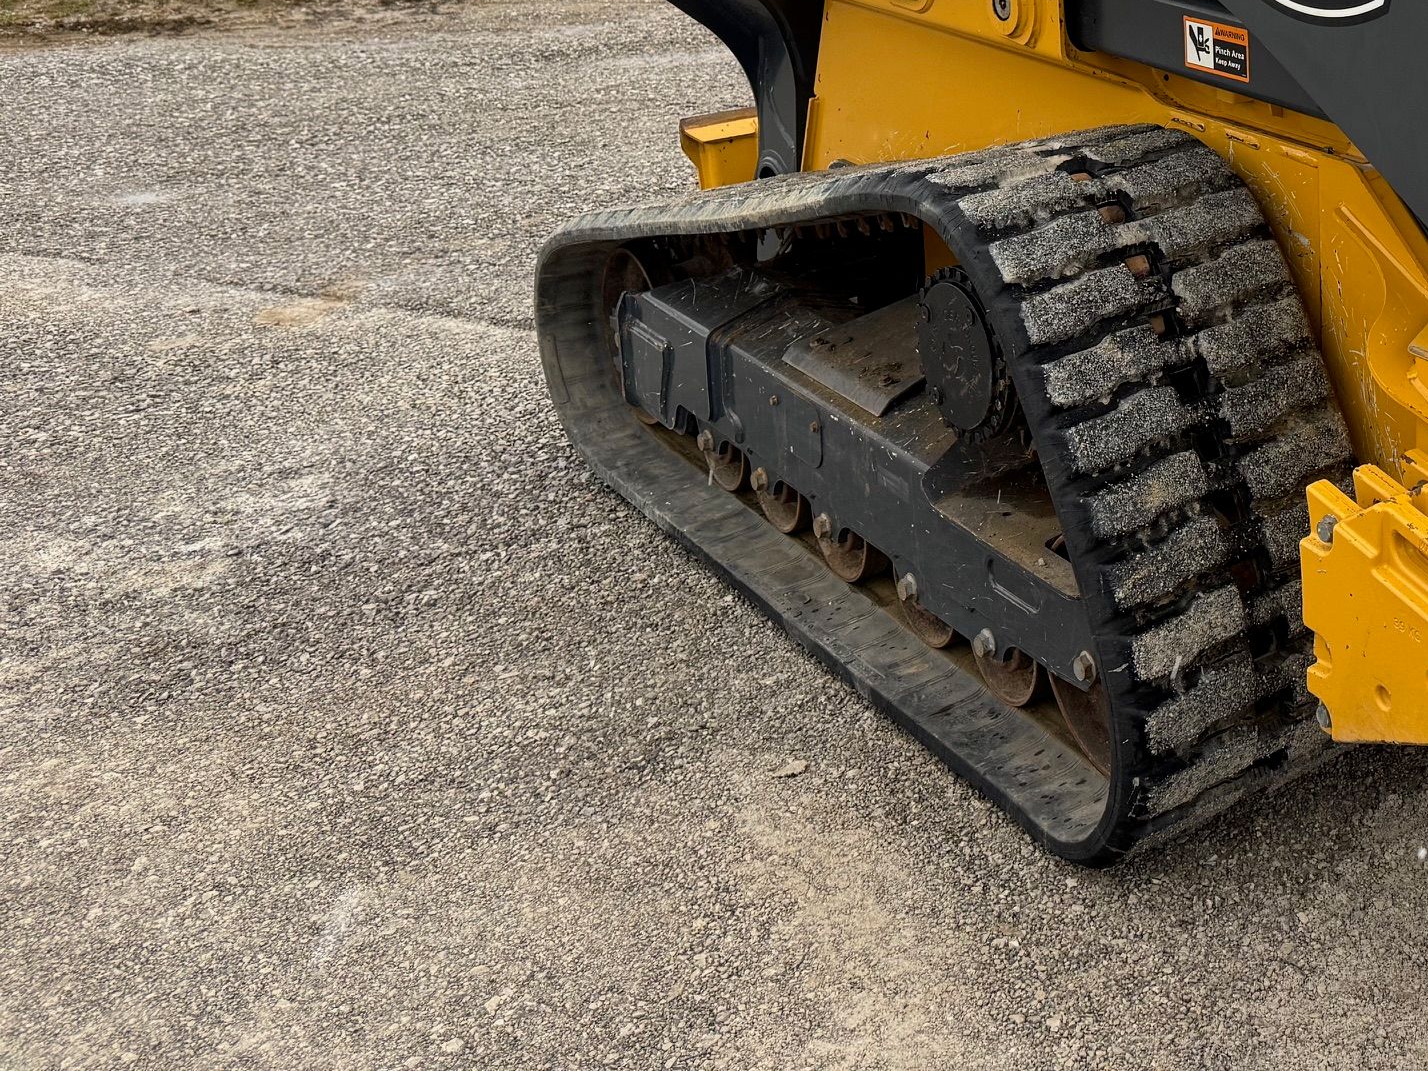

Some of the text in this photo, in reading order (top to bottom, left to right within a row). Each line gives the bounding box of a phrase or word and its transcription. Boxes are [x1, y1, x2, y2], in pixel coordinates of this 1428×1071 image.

[1219, 29, 1245, 41] WARNING
[1214, 45, 1245, 60] Pinch Area
[1215, 57, 1241, 70] Keep Away
